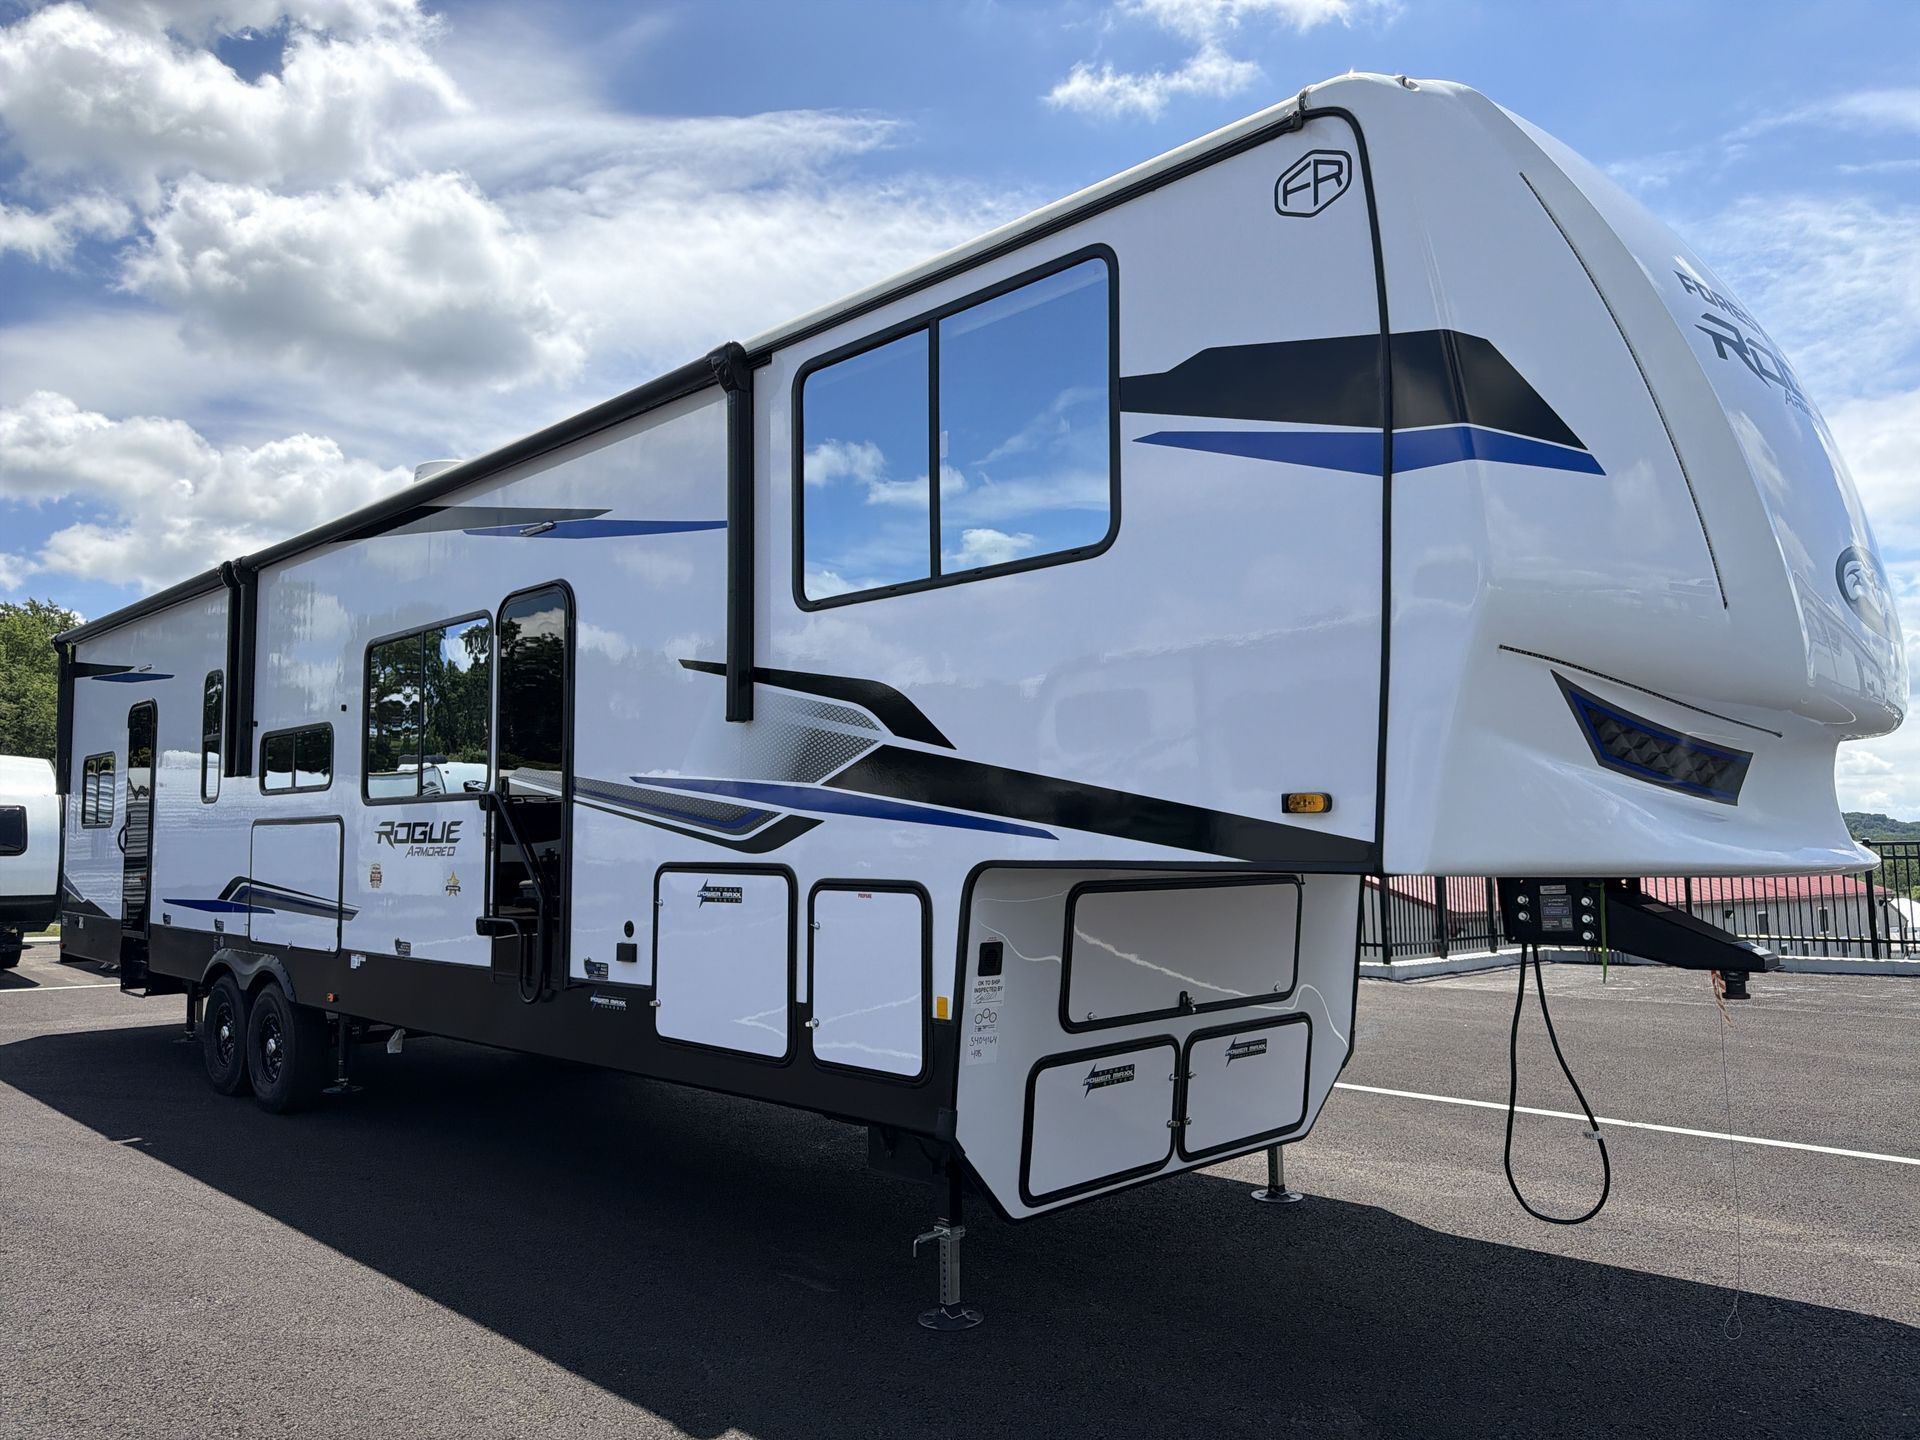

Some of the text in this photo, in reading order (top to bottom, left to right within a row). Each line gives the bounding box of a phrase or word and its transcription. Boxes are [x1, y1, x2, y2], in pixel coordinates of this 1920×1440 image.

[374, 820, 464, 849] ROGUE
[405, 845, 456, 858] ARMORED
[698, 890, 742, 899] POWER MAXX
[991, 978, 1001, 986] SHIP
[1084, 1069, 1134, 1086] POWER MAXX
